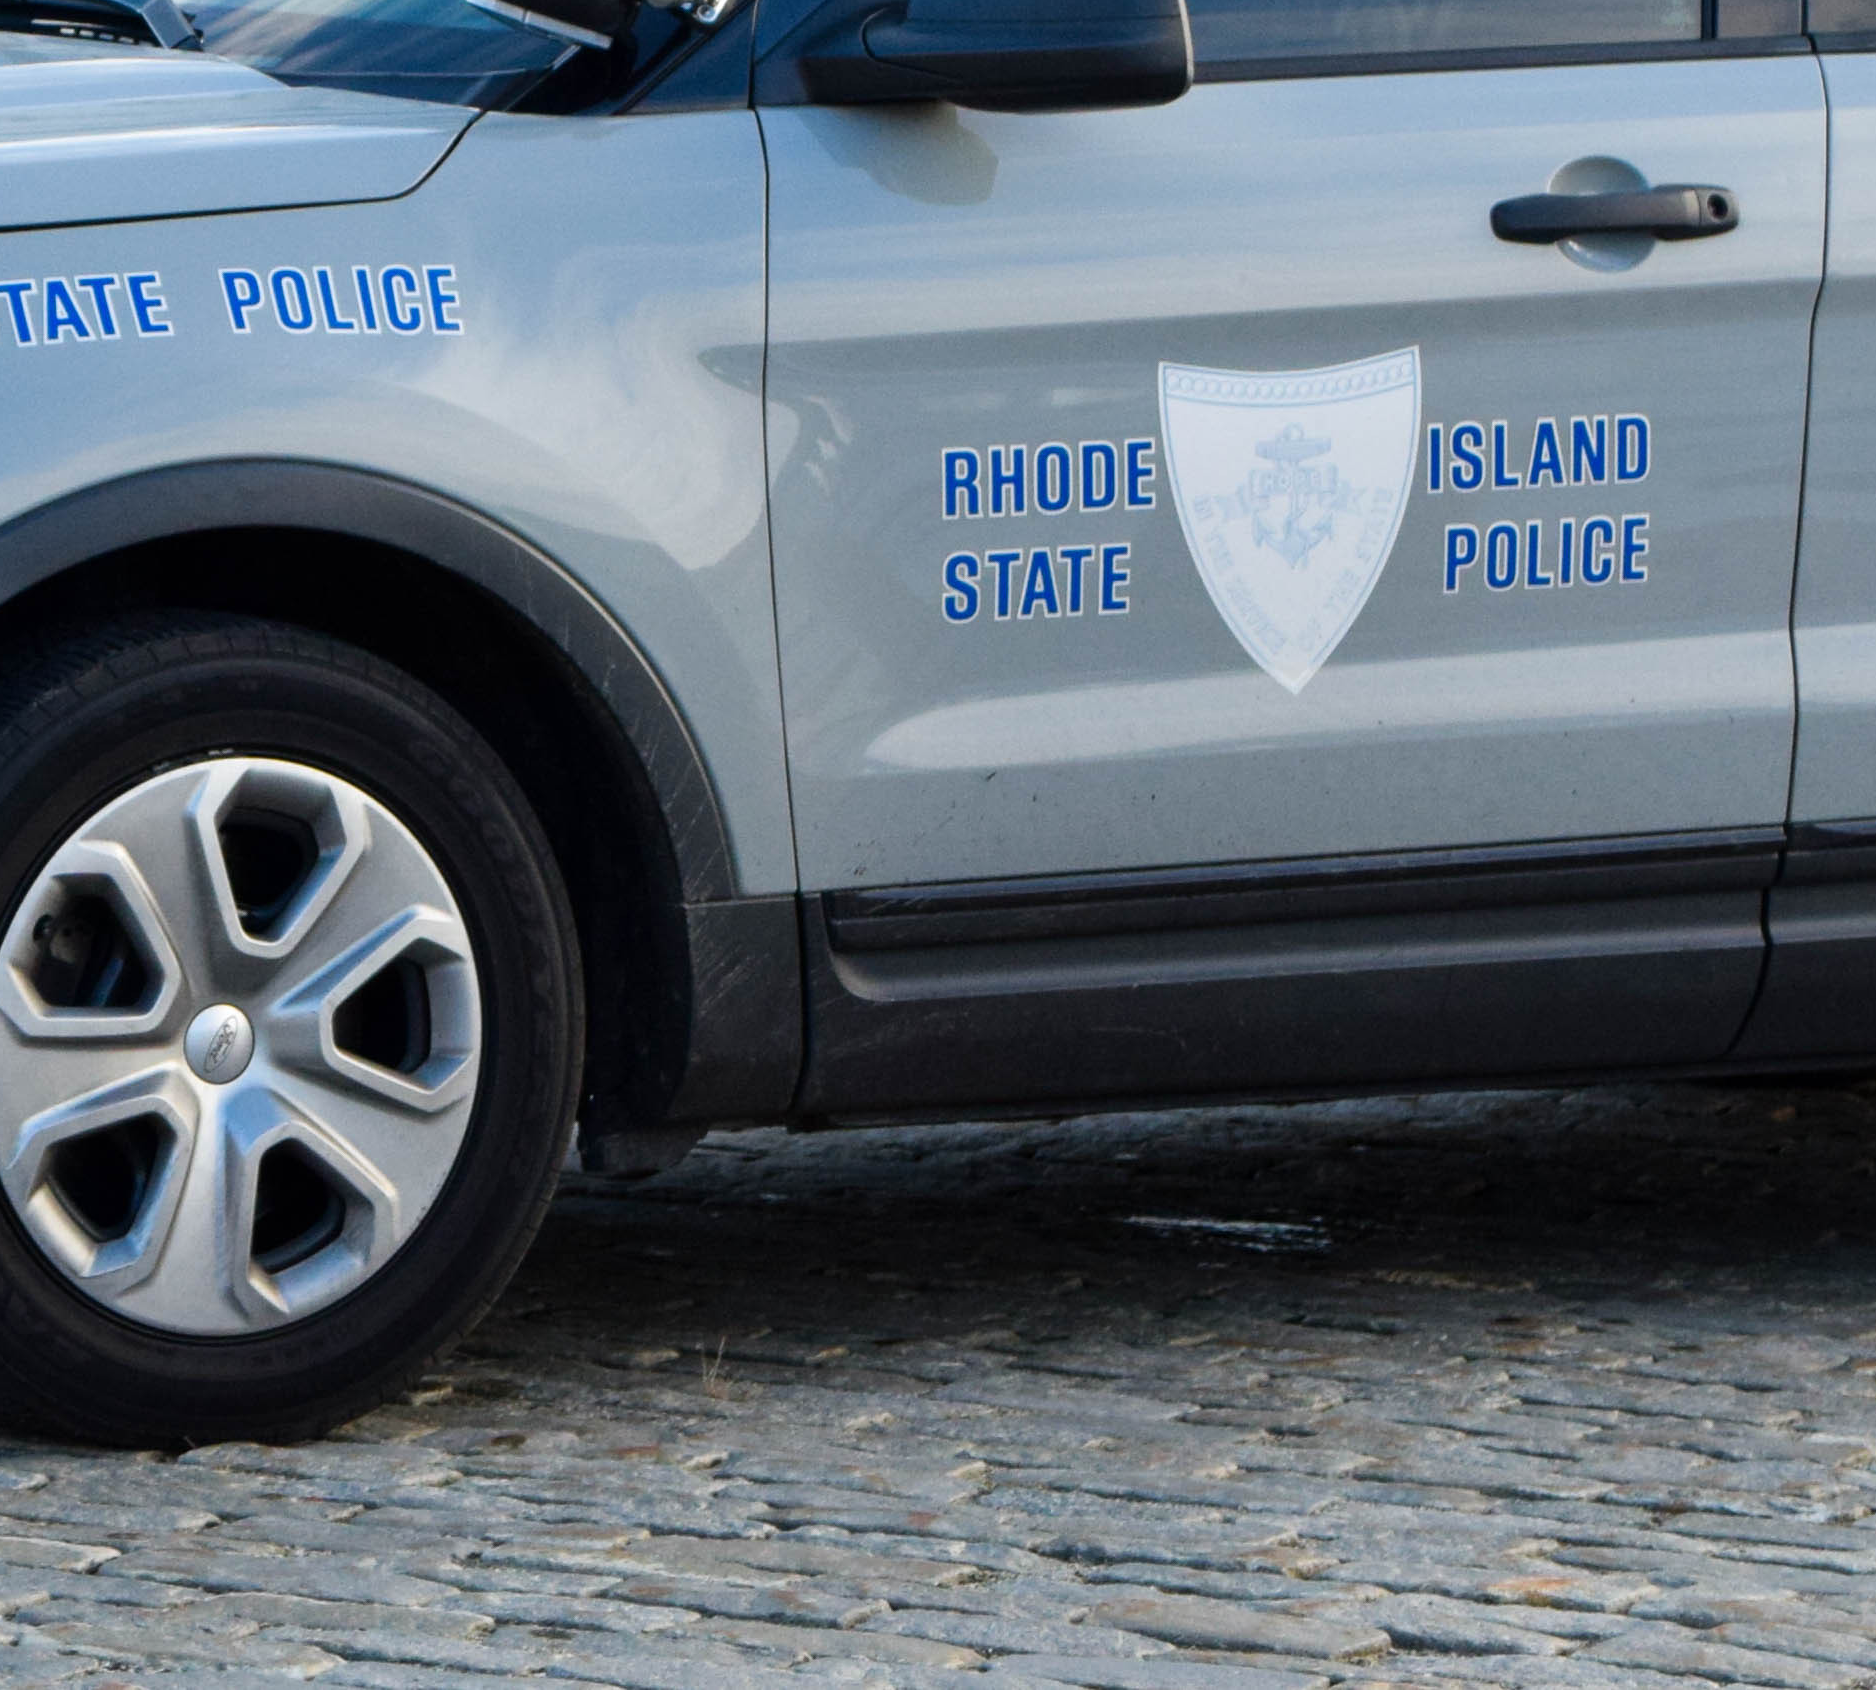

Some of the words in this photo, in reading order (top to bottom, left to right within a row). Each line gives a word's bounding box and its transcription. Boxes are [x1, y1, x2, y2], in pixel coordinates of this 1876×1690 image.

[218, 264, 464, 336] POLICE
[942, 437, 1155, 520] RHODE
[1427, 414, 1650, 494] ISLAND
[942, 543, 1131, 624] STATE
[1443, 512, 1650, 594] POLICE
